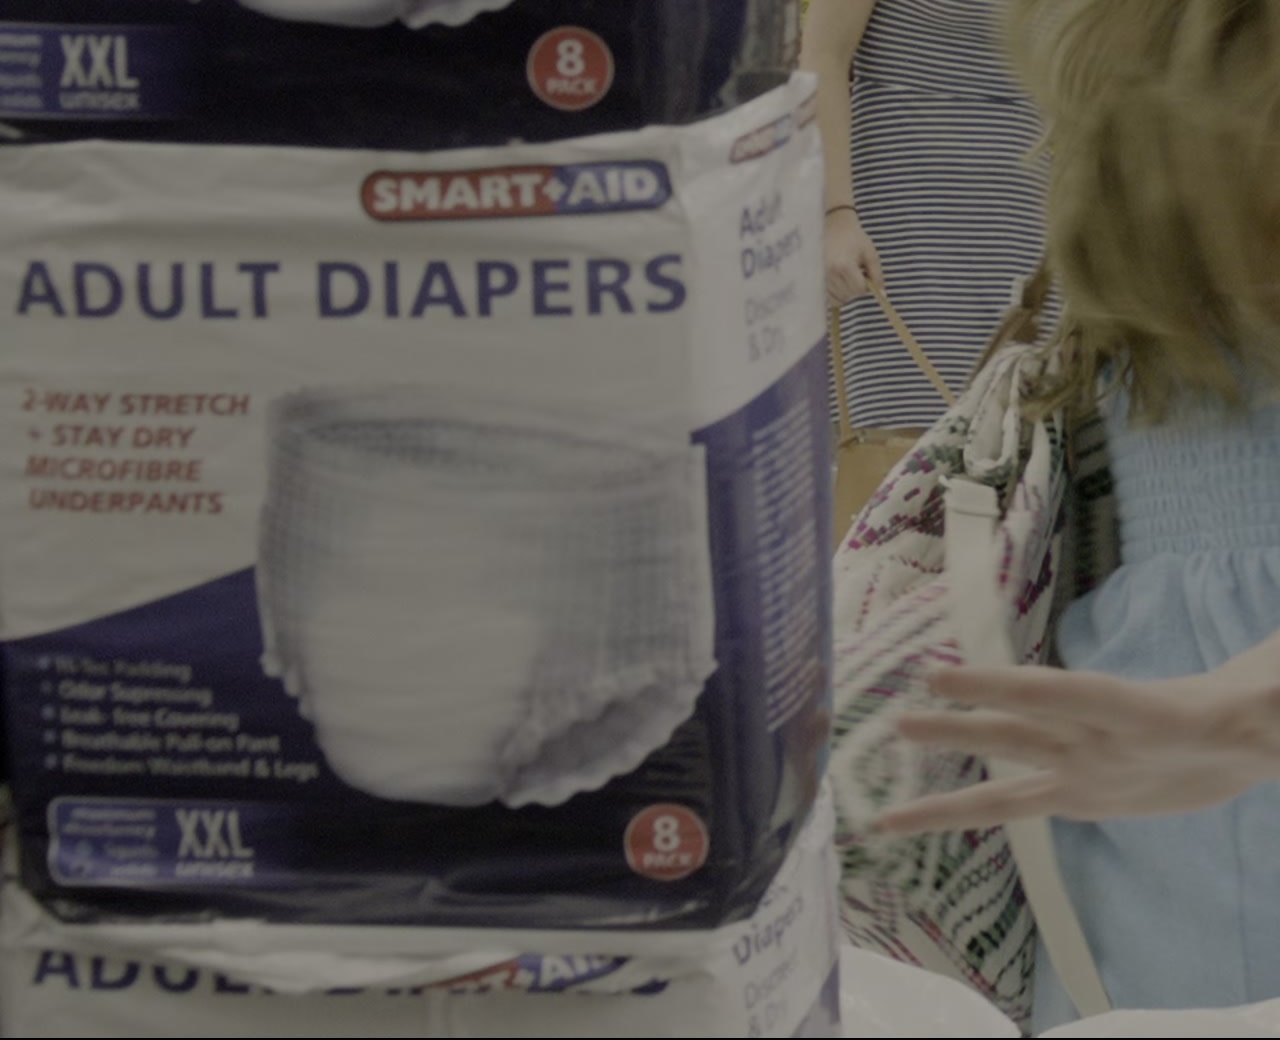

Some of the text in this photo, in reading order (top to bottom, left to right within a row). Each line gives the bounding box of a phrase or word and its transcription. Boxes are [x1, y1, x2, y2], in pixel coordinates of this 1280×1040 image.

[60, 35, 140, 89] XXL
[556, 40, 585, 77] 8
[372, 168, 659, 213] SMART+AID
[16, 253, 688, 320] ADULT DIAPERS
[22, 390, 251, 417] 2-WAY STRETCH
[50, 424, 126, 449] STAY
[133, 425, 195, 450] DRY
[25, 456, 201, 482] MICROFIBRE
[29, 490, 225, 516] UNDERPANTS
[175, 808, 255, 859] XXL
[651, 815, 680, 851] 8
